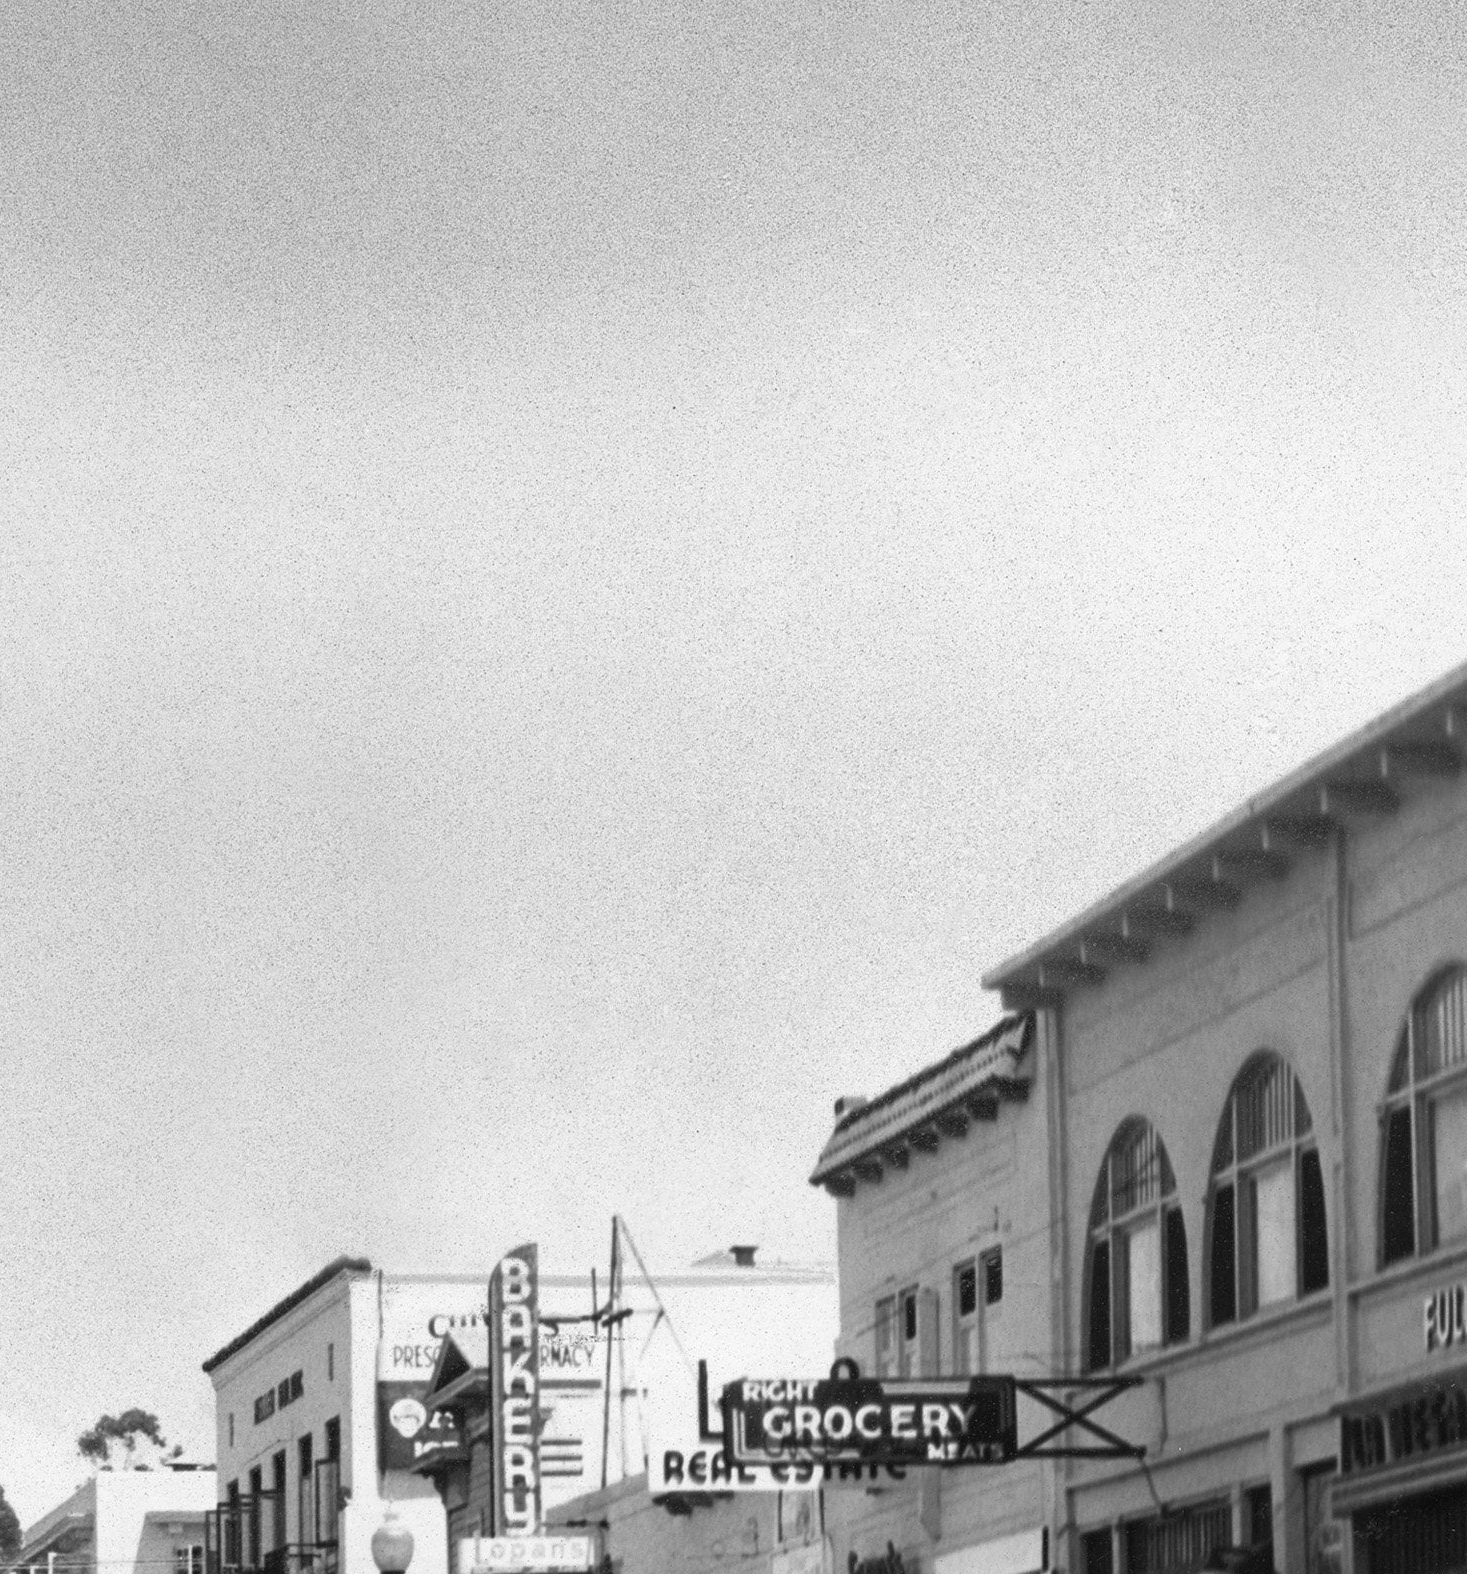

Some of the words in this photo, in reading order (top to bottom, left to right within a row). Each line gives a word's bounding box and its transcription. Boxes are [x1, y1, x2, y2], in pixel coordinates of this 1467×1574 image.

[1424, 1286, 1467, 1350] FUL
[499, 1257, 535, 1539] BAKERY
[763, 1404, 975, 1440] GROCERY
[927, 1443, 1005, 1460] MEATS
